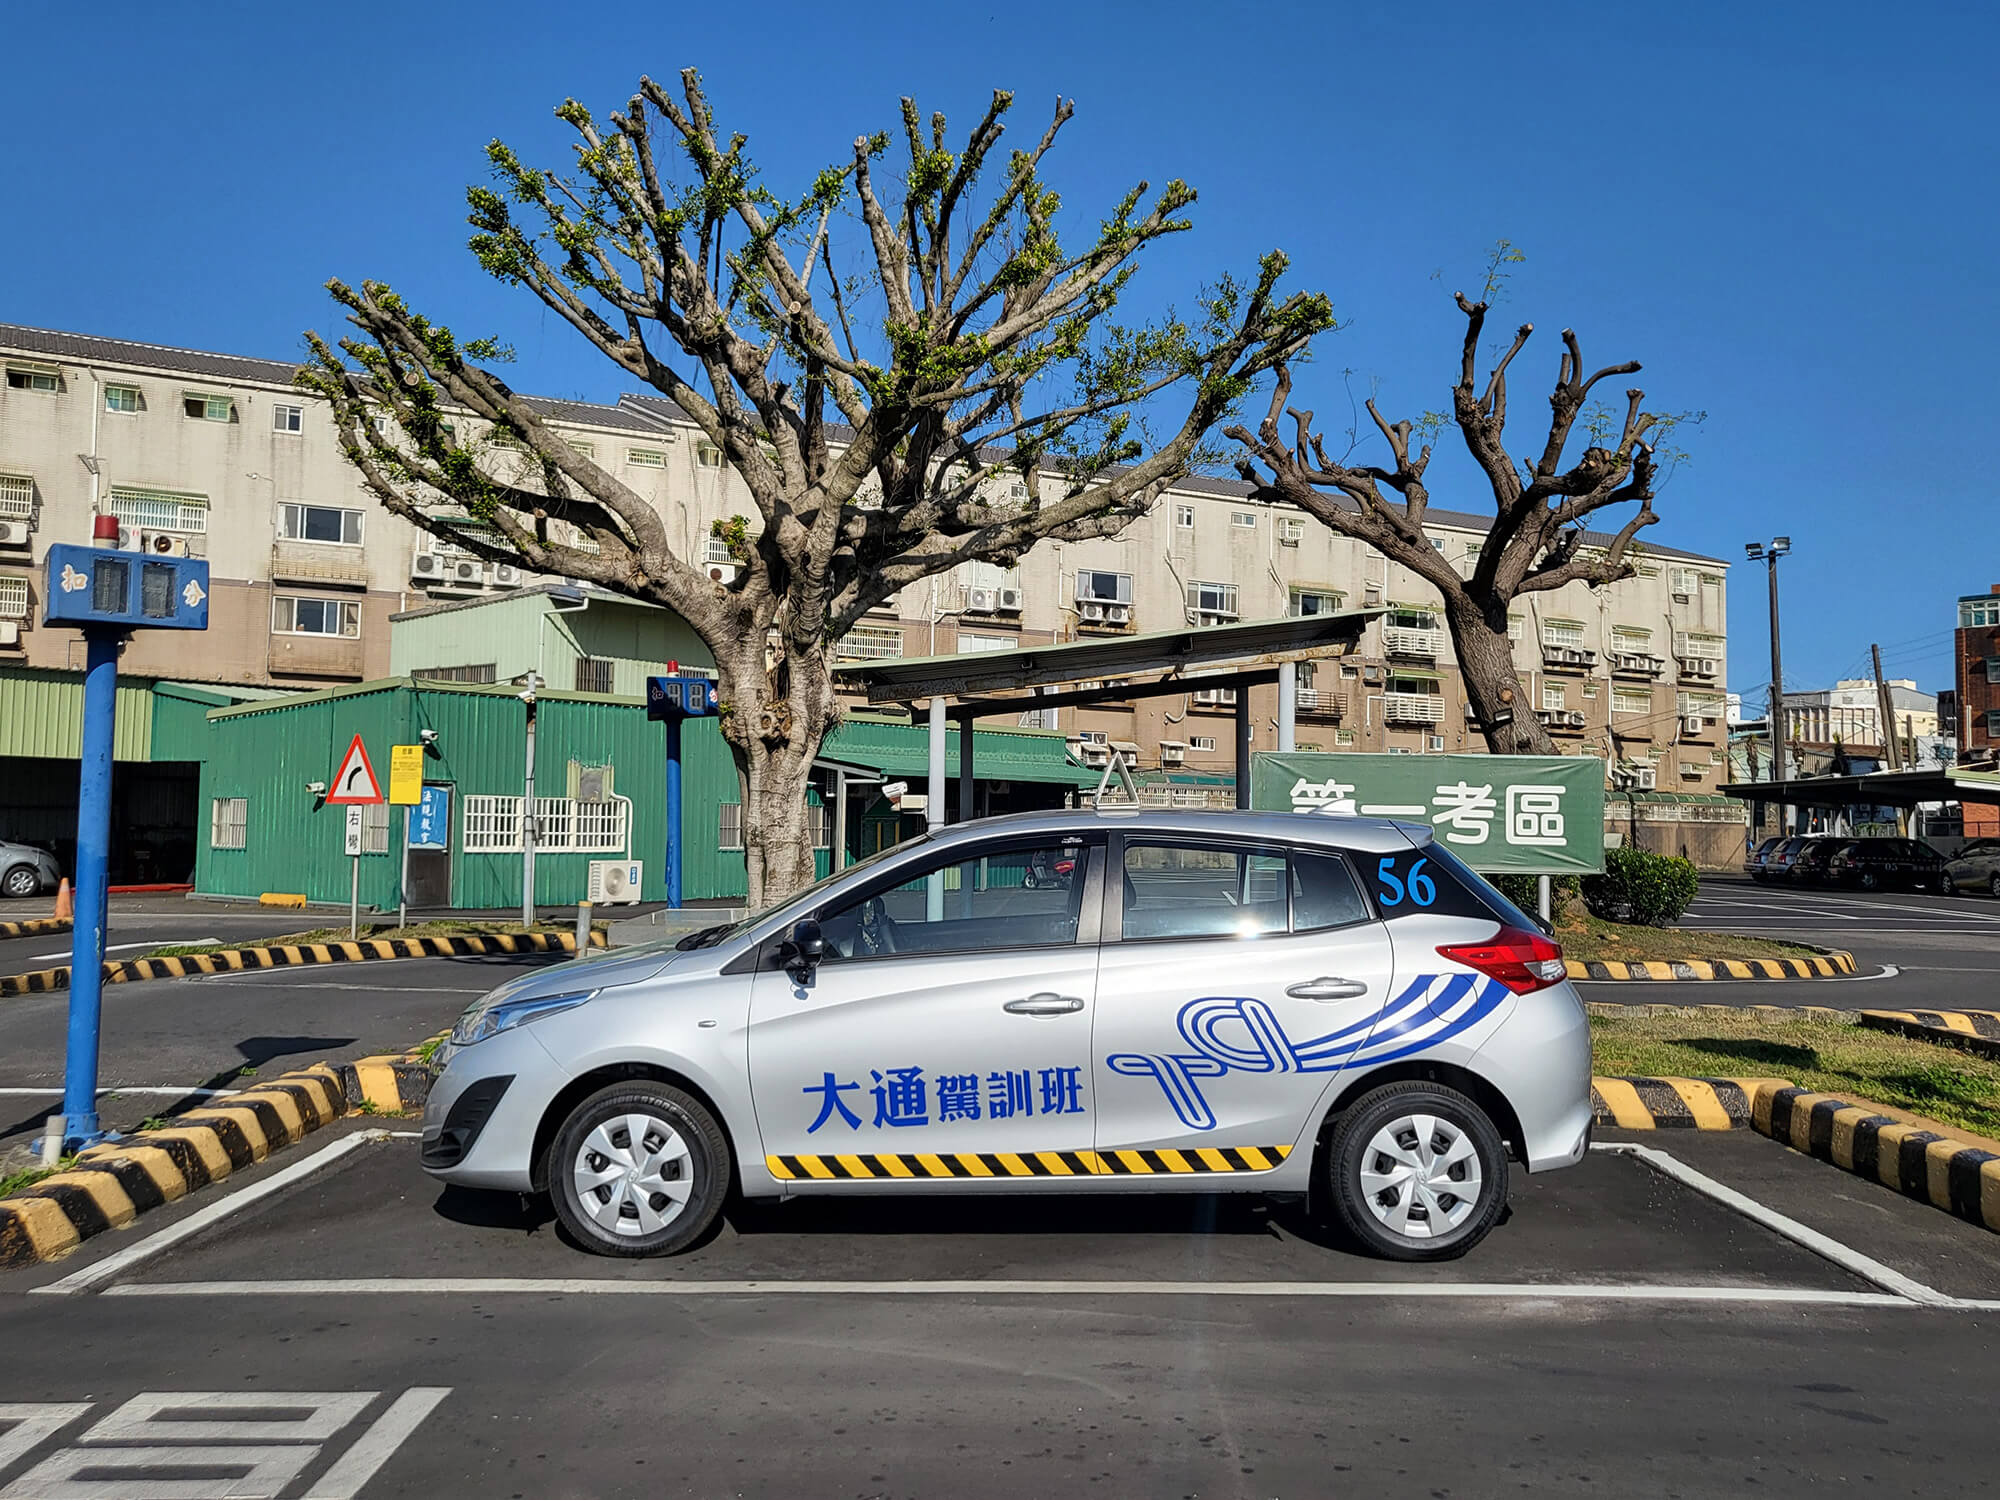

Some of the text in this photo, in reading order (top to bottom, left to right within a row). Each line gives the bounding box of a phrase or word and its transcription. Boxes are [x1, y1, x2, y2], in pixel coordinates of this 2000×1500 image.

[61, 563, 207, 608] 扣 分
[1377, 857, 1436, 907] 56
[802, 1065, 1086, 1134] 大通駕訓班
